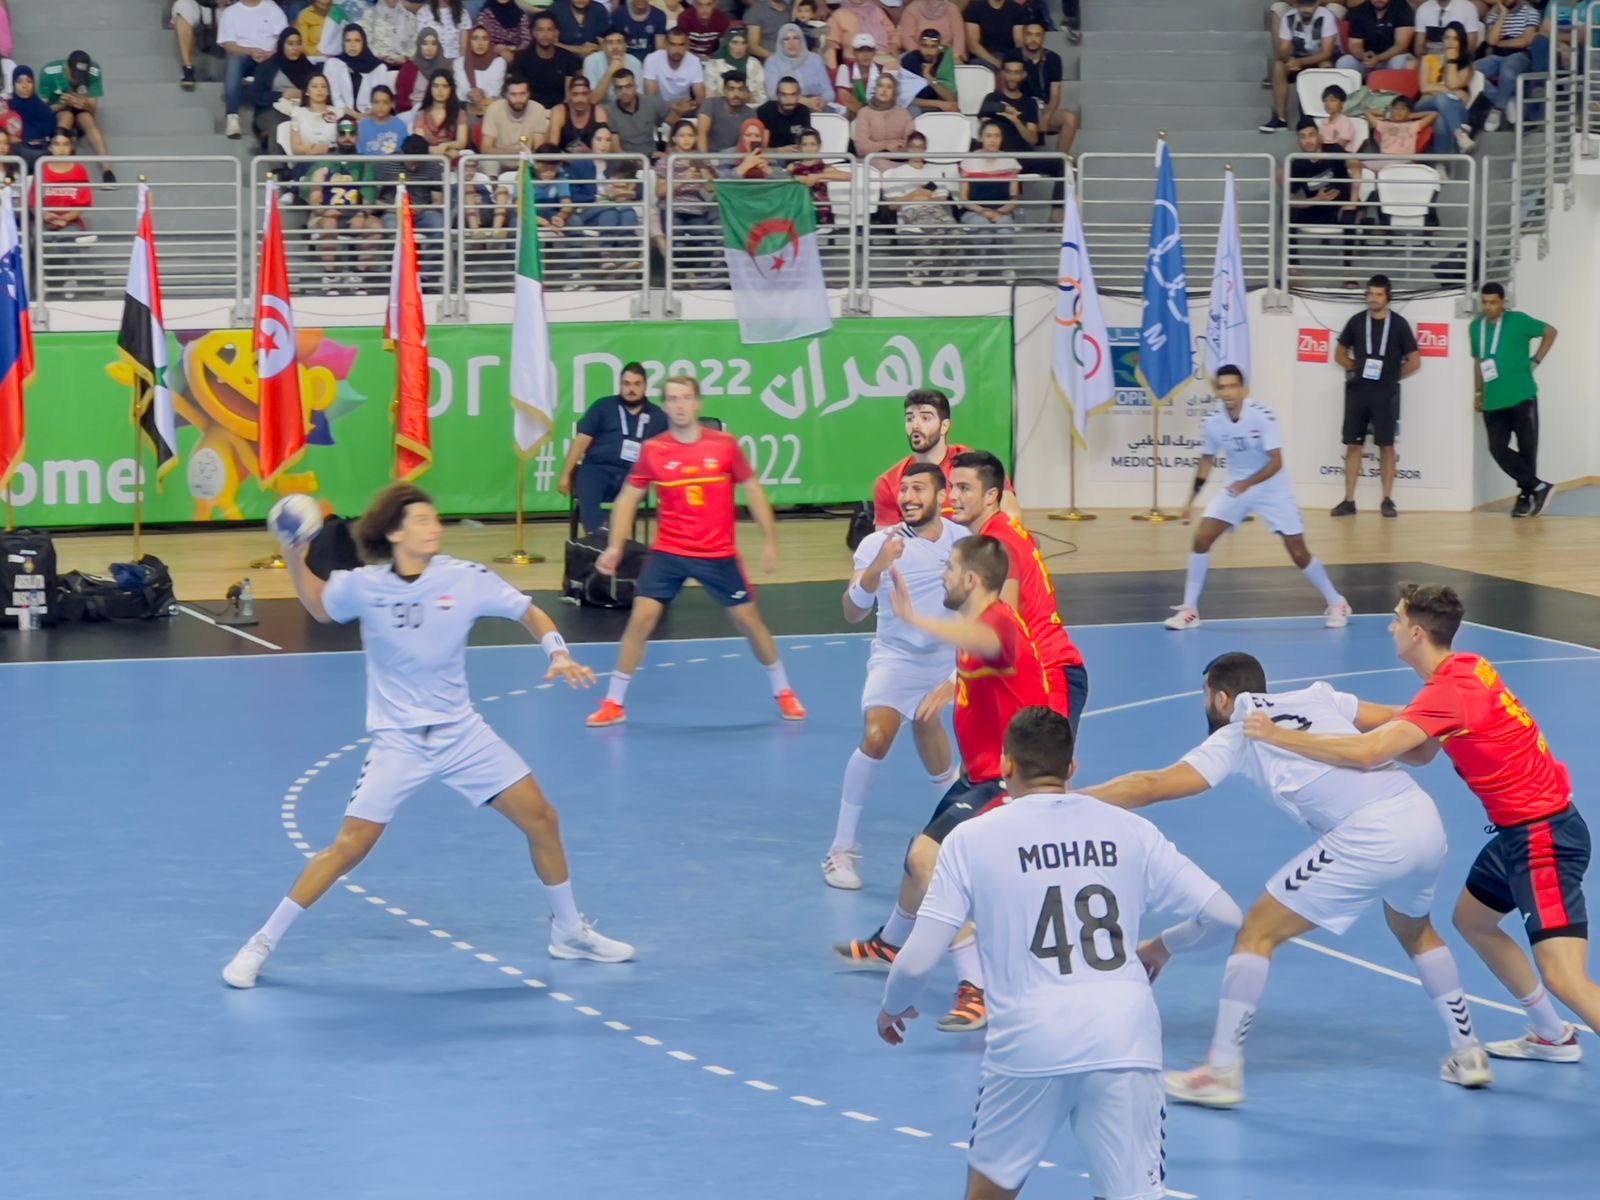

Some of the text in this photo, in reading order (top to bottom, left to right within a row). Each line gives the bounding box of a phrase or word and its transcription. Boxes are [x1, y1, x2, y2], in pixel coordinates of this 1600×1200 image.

[761, 335, 966, 419] وهران
[1111, 456, 1172, 468] MEDICAL
[1018, 840, 1118, 873] MOHAB
[1029, 884, 1127, 975] 48
